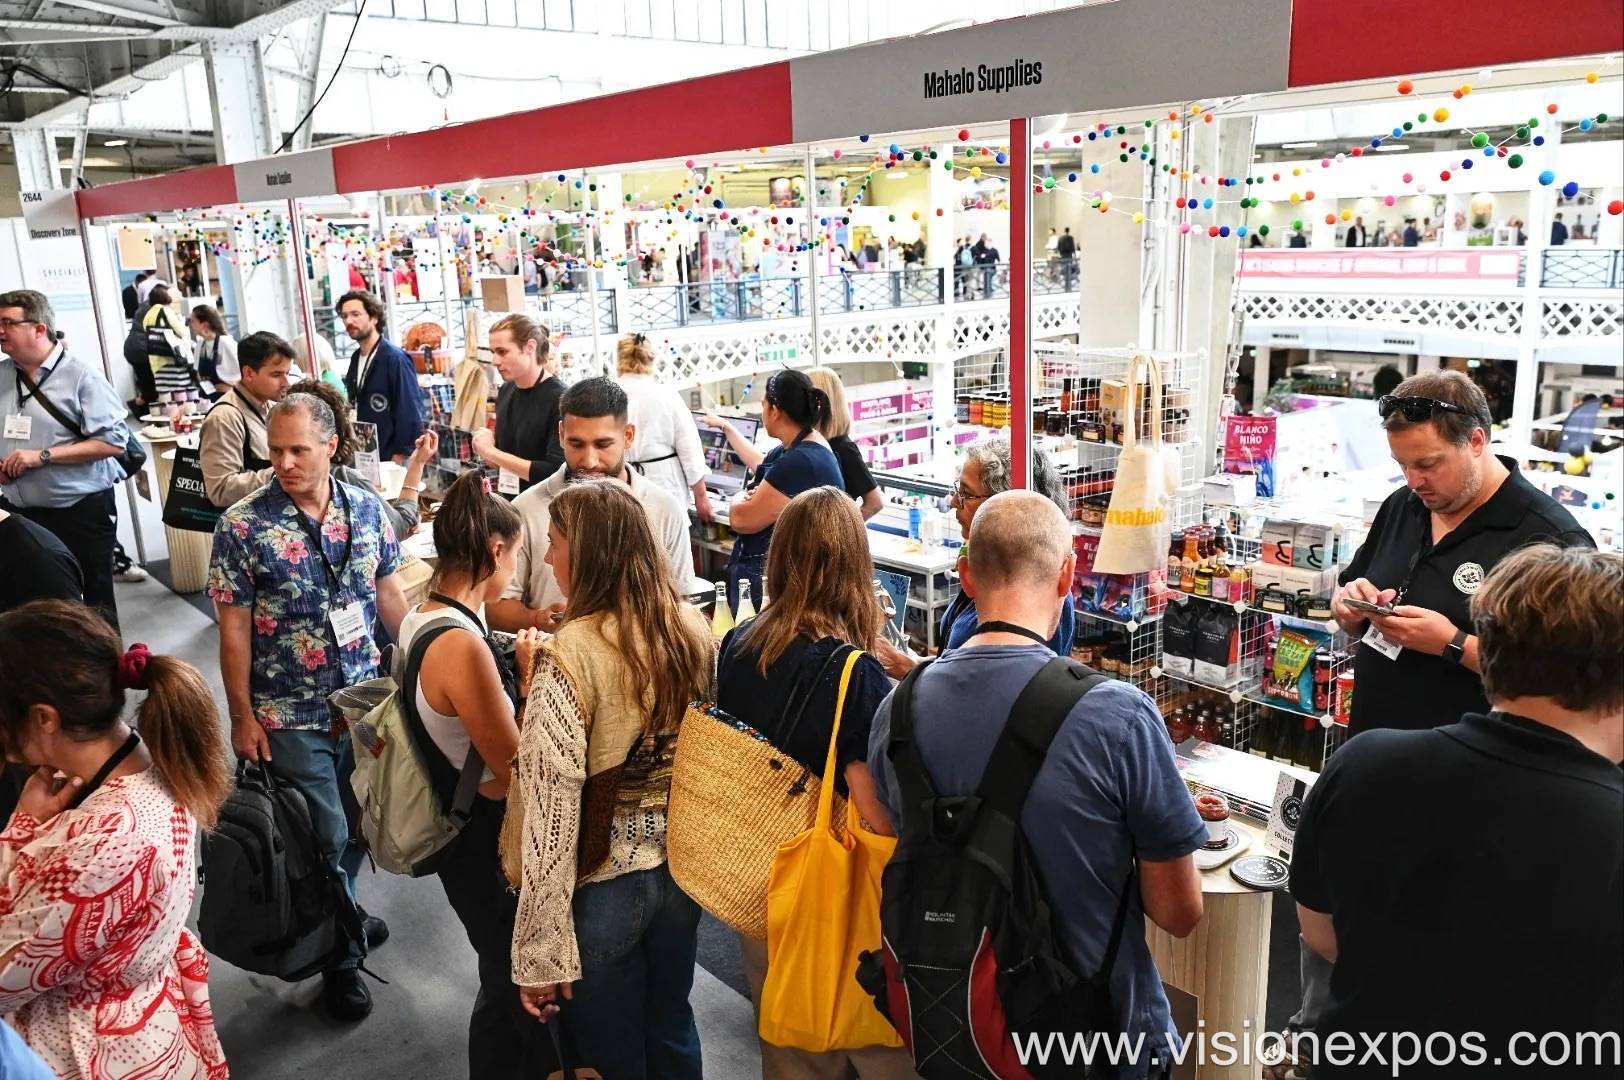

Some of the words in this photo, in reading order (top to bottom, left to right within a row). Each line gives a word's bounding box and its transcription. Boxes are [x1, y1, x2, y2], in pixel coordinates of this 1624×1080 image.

[924, 66, 975, 99] Mahalo
[977, 58, 1042, 94] Supplies
[22, 192, 43, 203] 2644
[30, 228, 61, 240] Discovery
[62, 227, 77, 237] Zone
[1234, 424, 1269, 434] BLANCO
[176, 477, 204, 492] SPECIA
[1083, 542, 1098, 552] BLA
[1274, 831, 1293, 846] COLLECT
